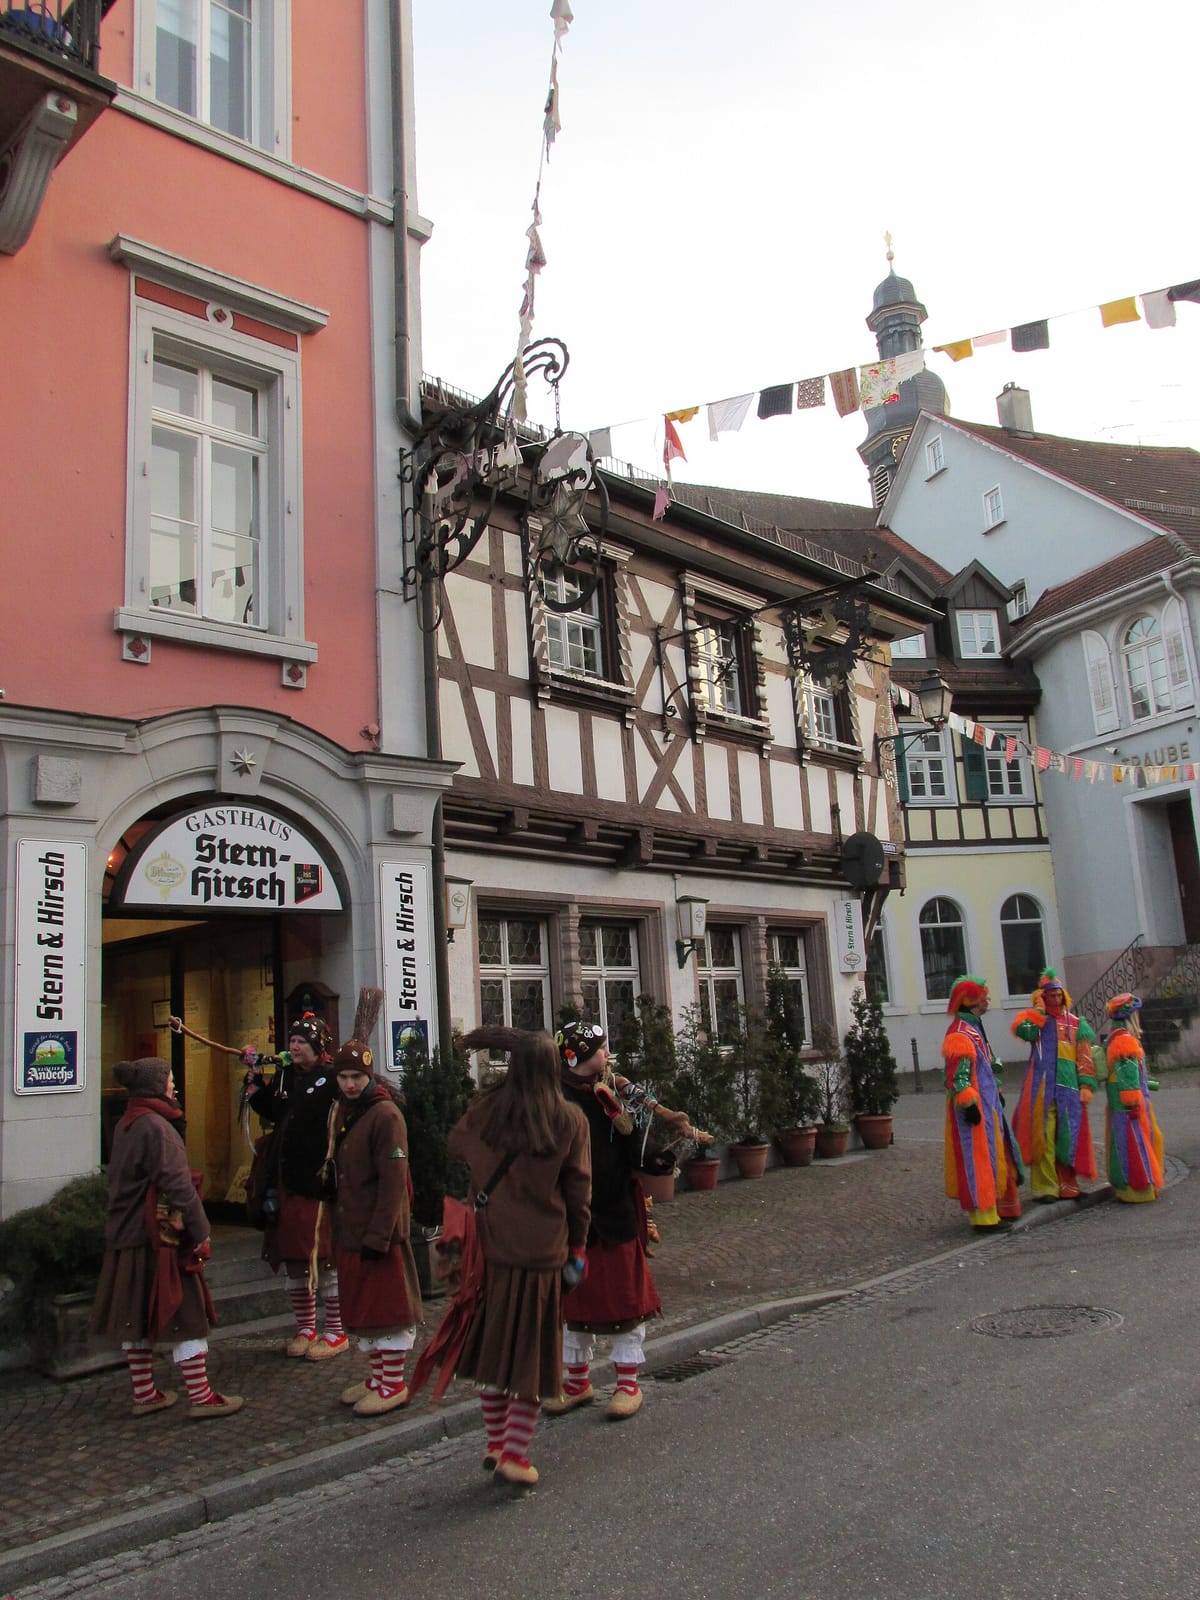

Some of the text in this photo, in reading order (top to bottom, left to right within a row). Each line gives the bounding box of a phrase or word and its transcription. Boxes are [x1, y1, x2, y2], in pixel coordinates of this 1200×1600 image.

[186, 810, 292, 842] GASTHAUS
[195, 833, 291, 868] Stern-
[191, 866, 285, 906] Hirsch
[395, 871, 415, 933] Hirsch
[36, 851, 65, 1021] Stern & Hirsch
[397, 938, 416, 952] &
[399, 955, 418, 1011] Stern
[27, 1067, 74, 1084] Andechs
